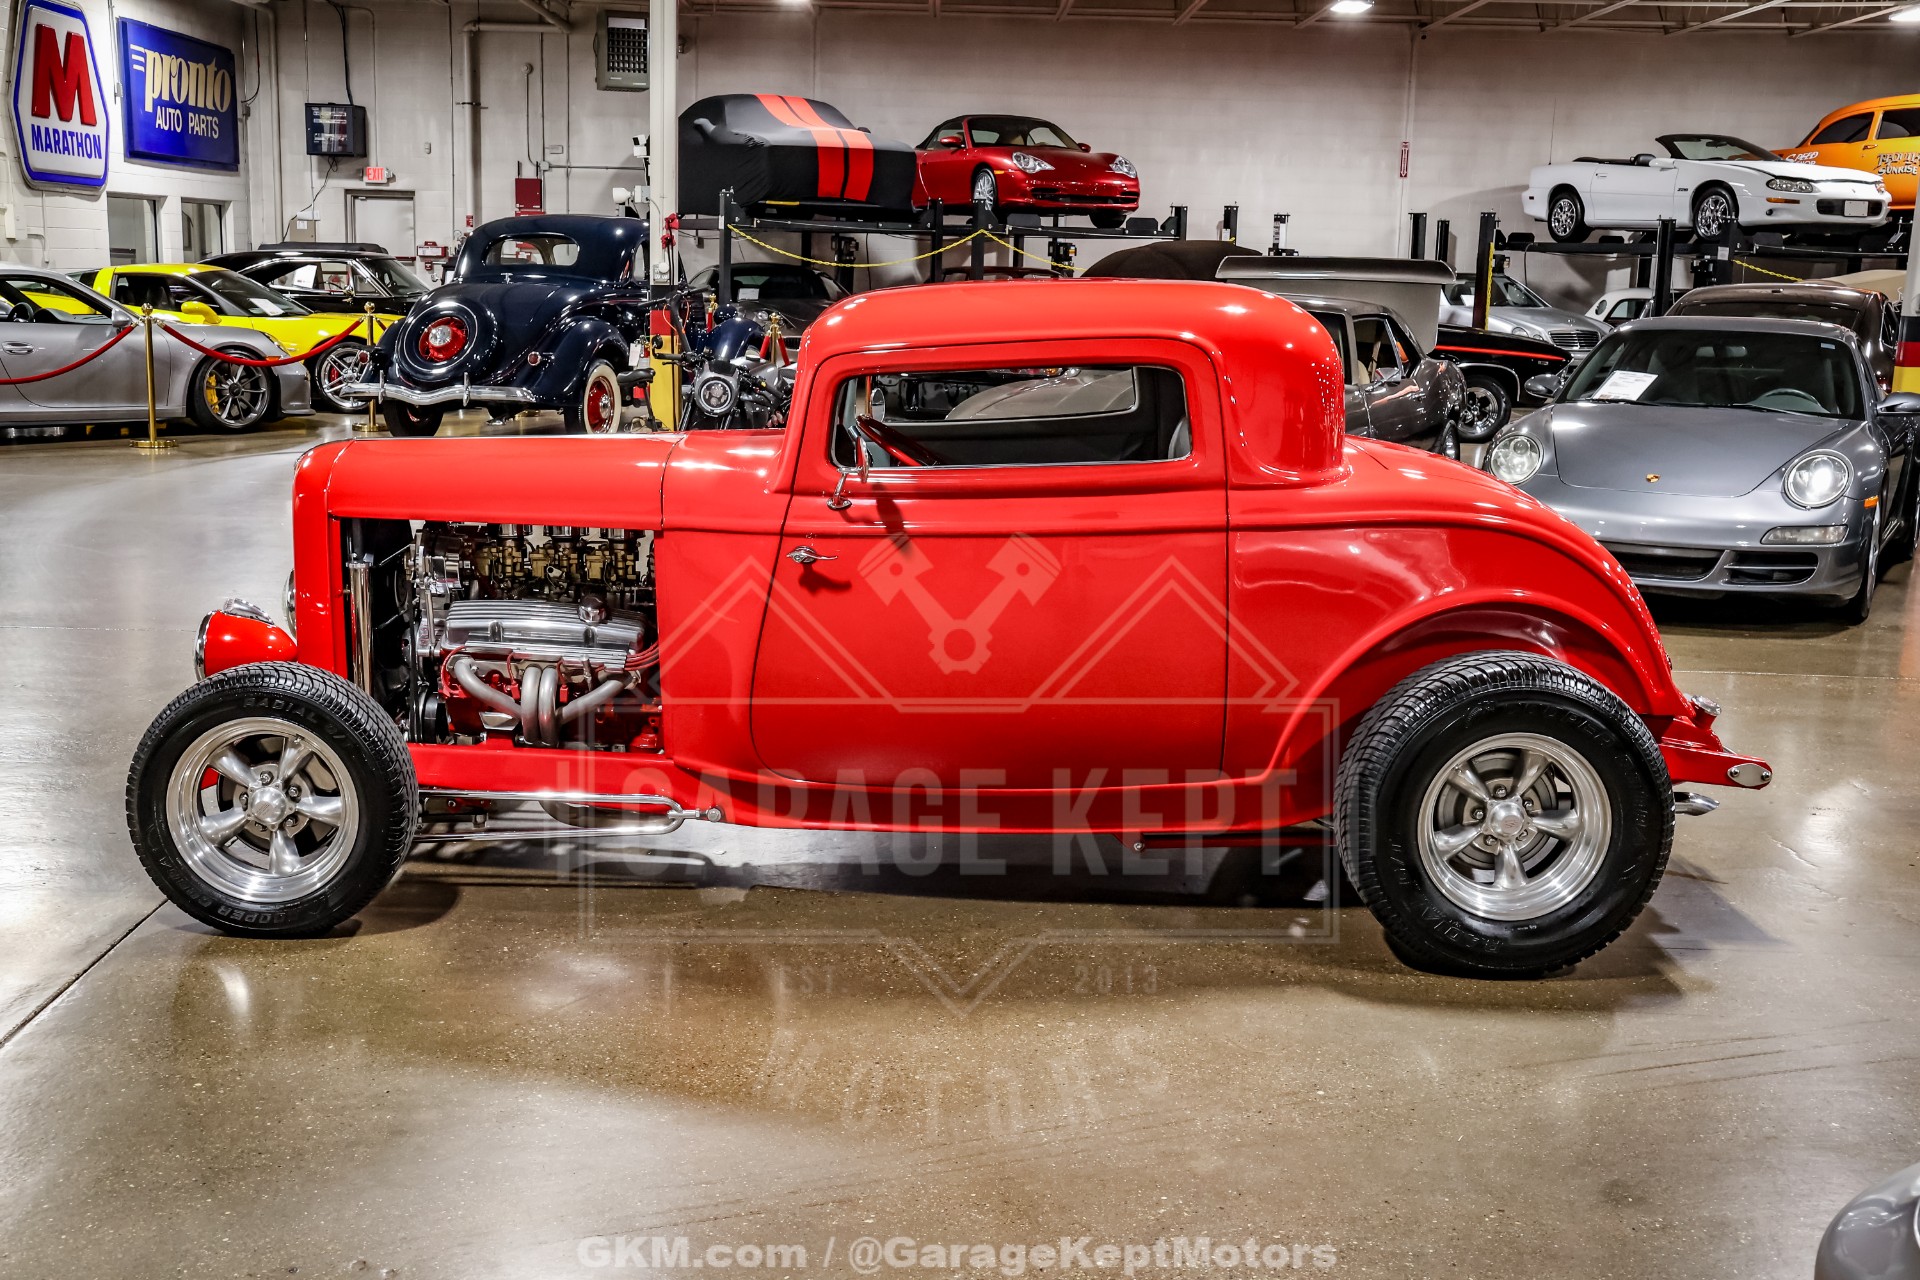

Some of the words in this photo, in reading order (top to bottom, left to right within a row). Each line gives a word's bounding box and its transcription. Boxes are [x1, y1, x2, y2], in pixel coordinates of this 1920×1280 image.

[32, 23, 97, 126] M
[145, 50, 231, 113] pronto
[155, 109, 182, 132] AUTO
[188, 114, 219, 139] PARTS
[31, 124, 102, 159] MARATHON
[366, 167, 384, 181] EXIT
[1878, 165, 1918, 176] SUNRISE
